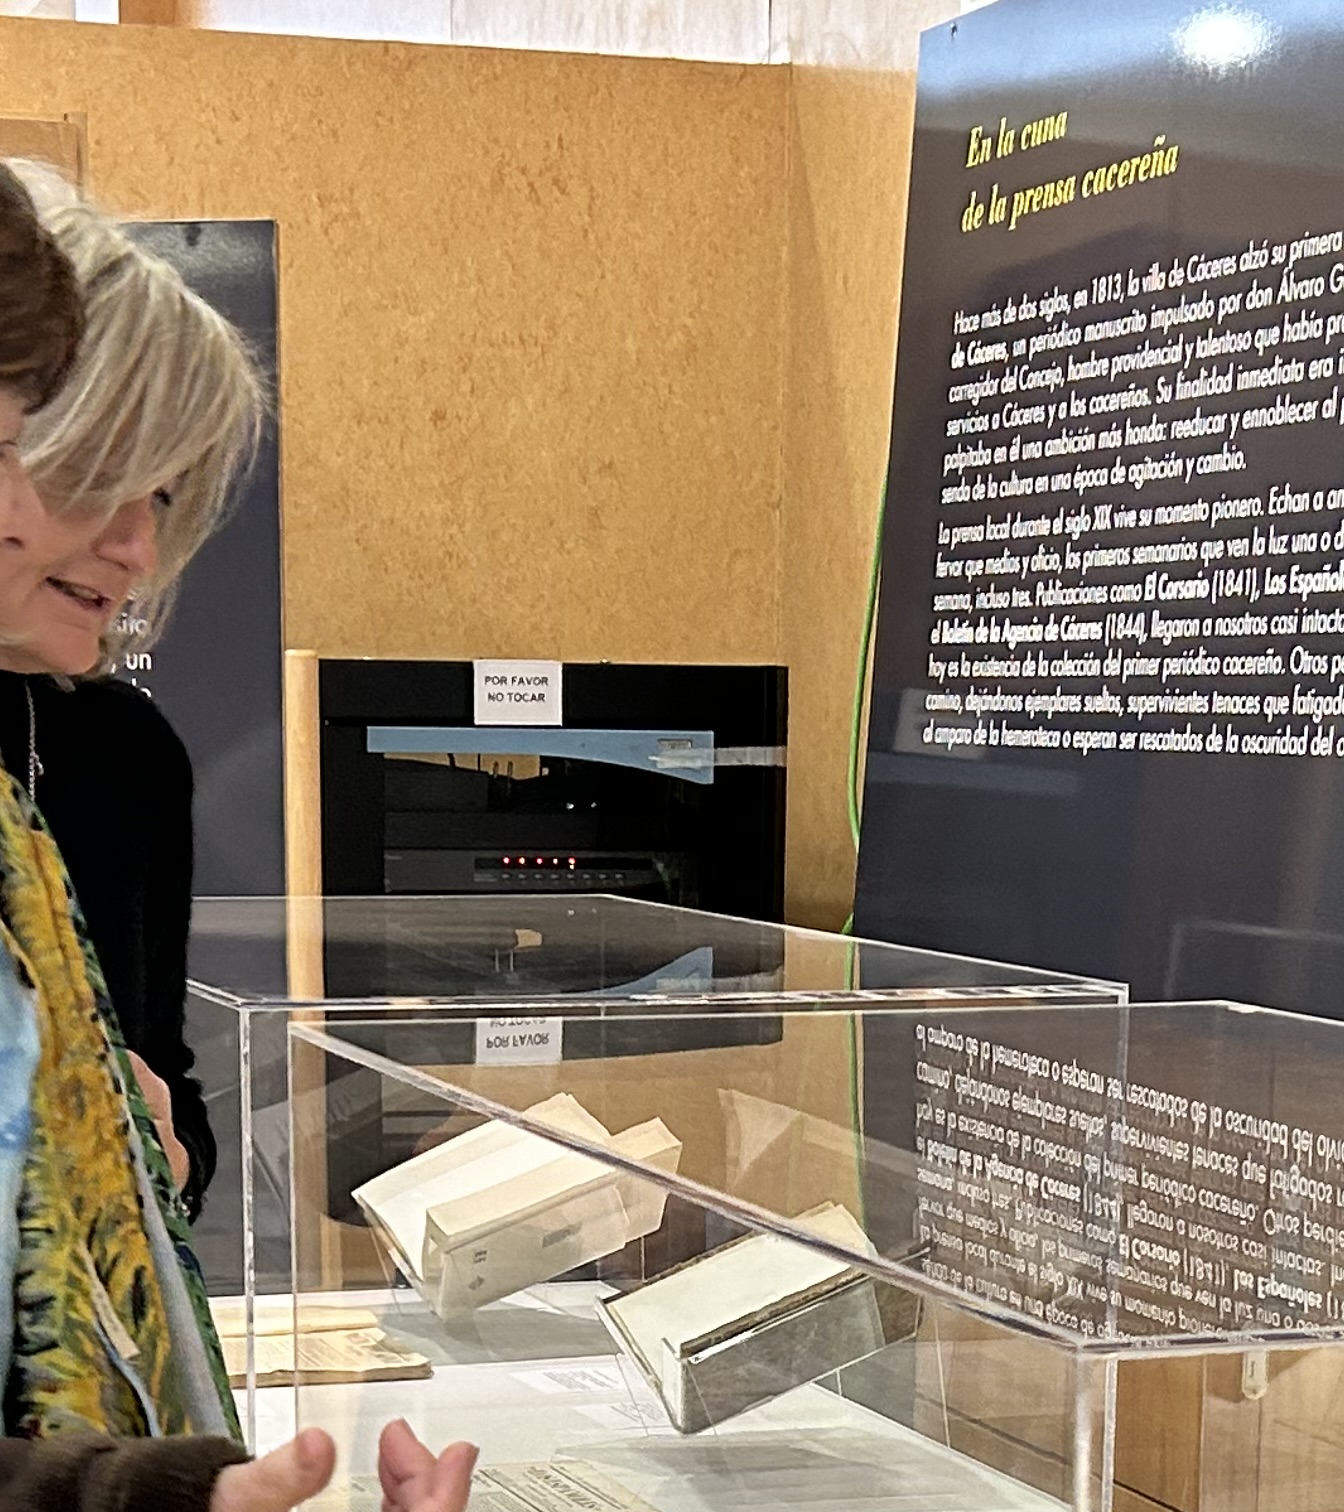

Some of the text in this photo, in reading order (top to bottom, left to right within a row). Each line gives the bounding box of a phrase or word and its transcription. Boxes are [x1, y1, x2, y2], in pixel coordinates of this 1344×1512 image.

[965, 111, 1068, 168] En la cuna
[961, 134, 1180, 232] de la prensa cacereña
[1288, 231, 1343, 268] primera
[1245, 278, 1273, 310] don
[1276, 266, 1325, 304] Álvaro
[1282, 309, 1324, 343] había
[1268, 482, 1310, 515] Echan
[1312, 490, 1324, 511] a
[126, 652, 152, 671] un
[484, 675, 549, 686] POR FAVOR
[487, 692, 546, 703] NO TOCAR
